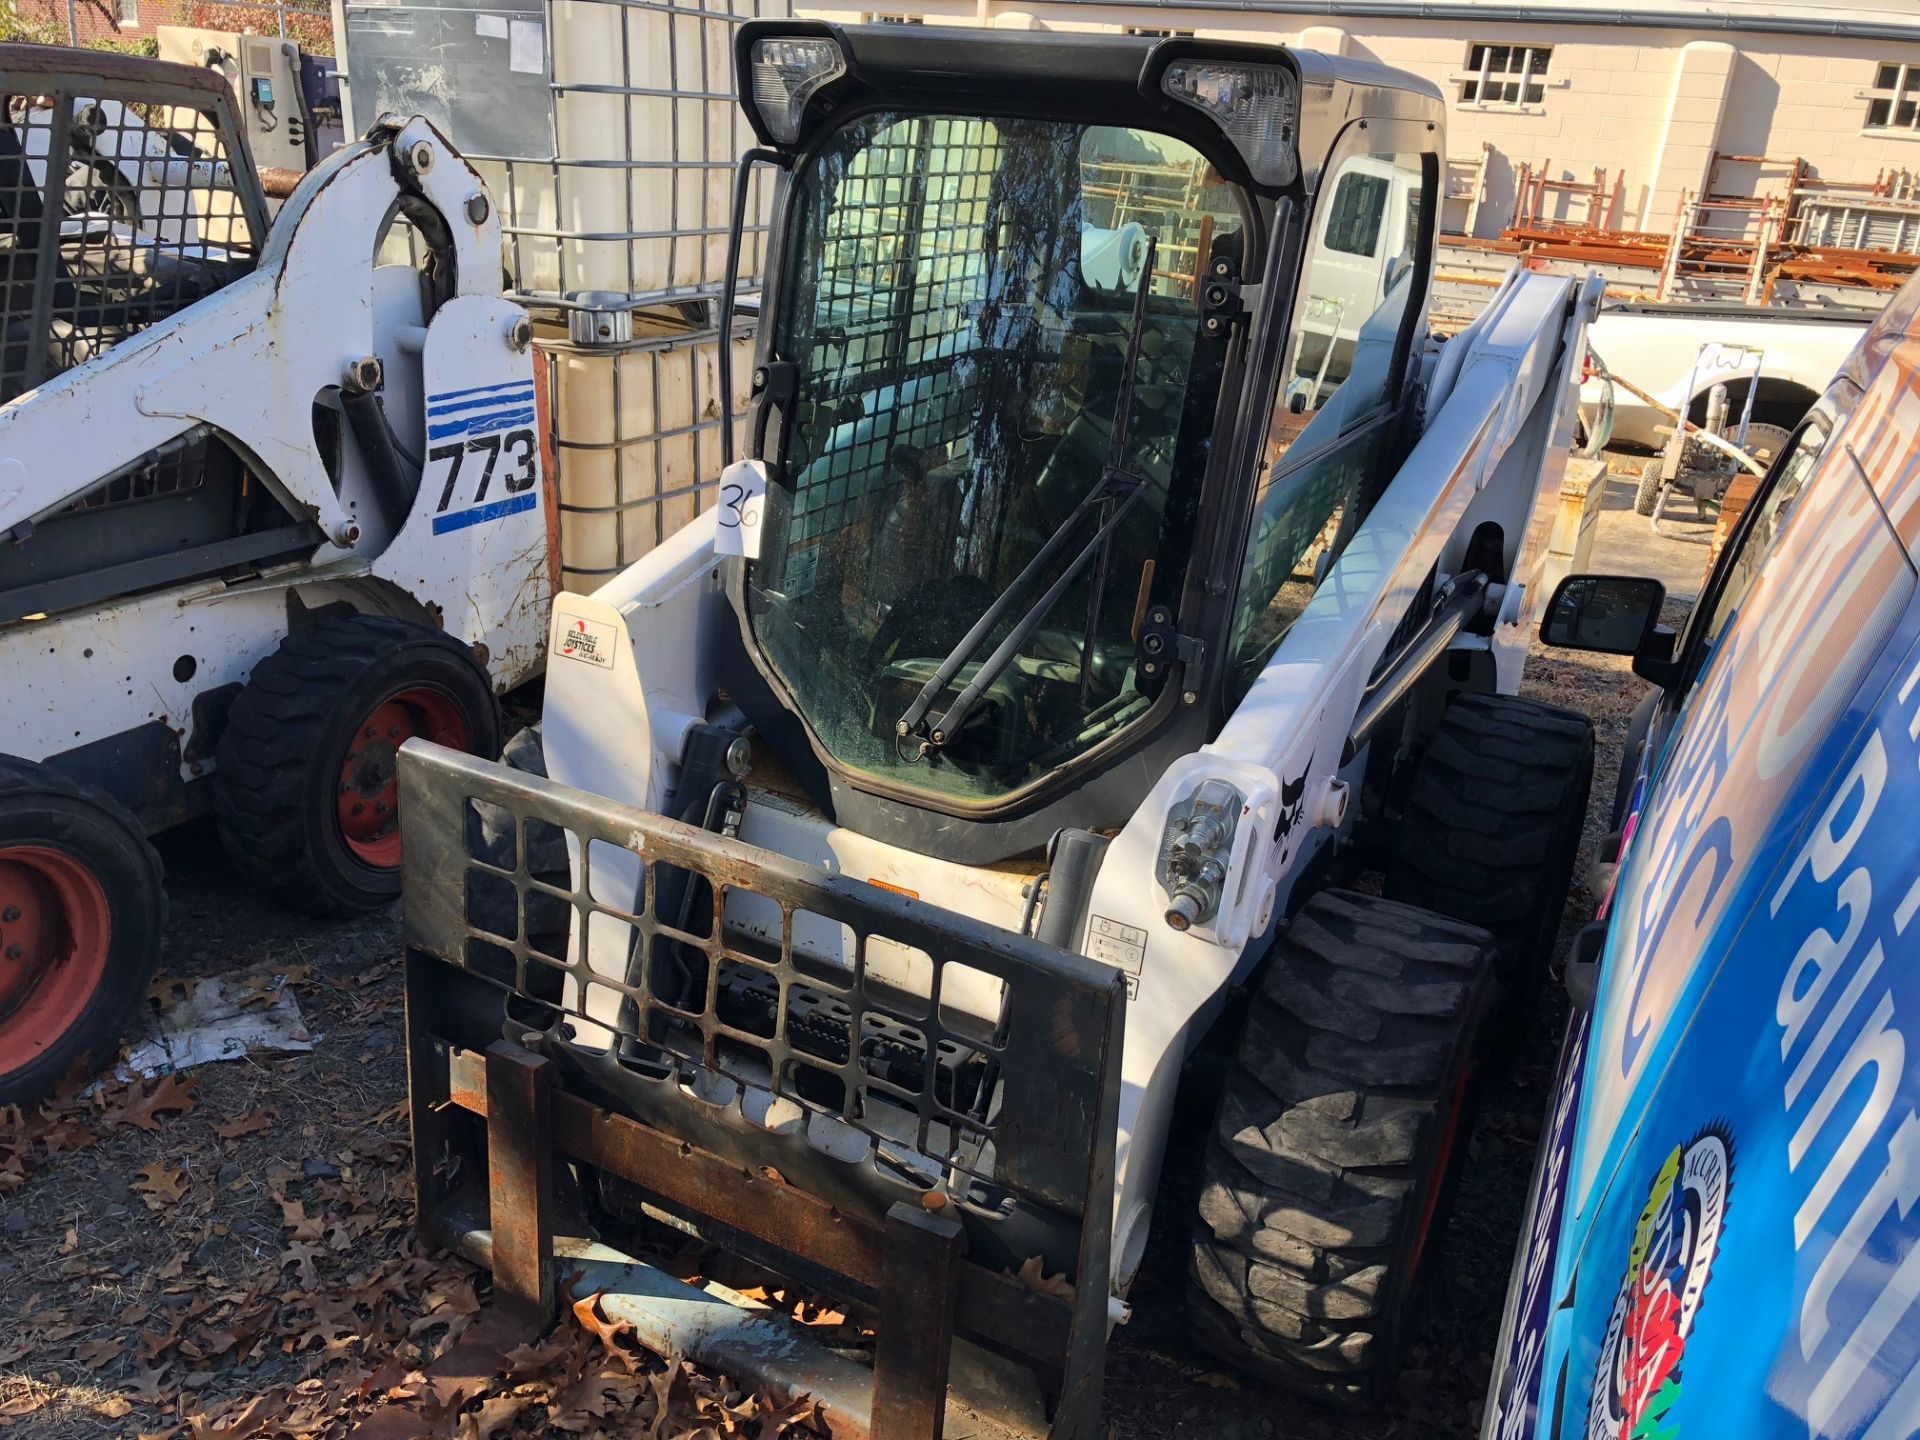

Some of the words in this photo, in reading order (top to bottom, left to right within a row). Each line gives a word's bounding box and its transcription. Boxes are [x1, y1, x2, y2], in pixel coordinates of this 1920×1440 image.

[429, 429, 538, 513] 773
[719, 484, 758, 527] 36
[1621, 631, 1740, 1080] SPEC
[1636, 1178, 1674, 1425] PDCA
[1682, 1148, 1722, 1313] ACCREDITED
